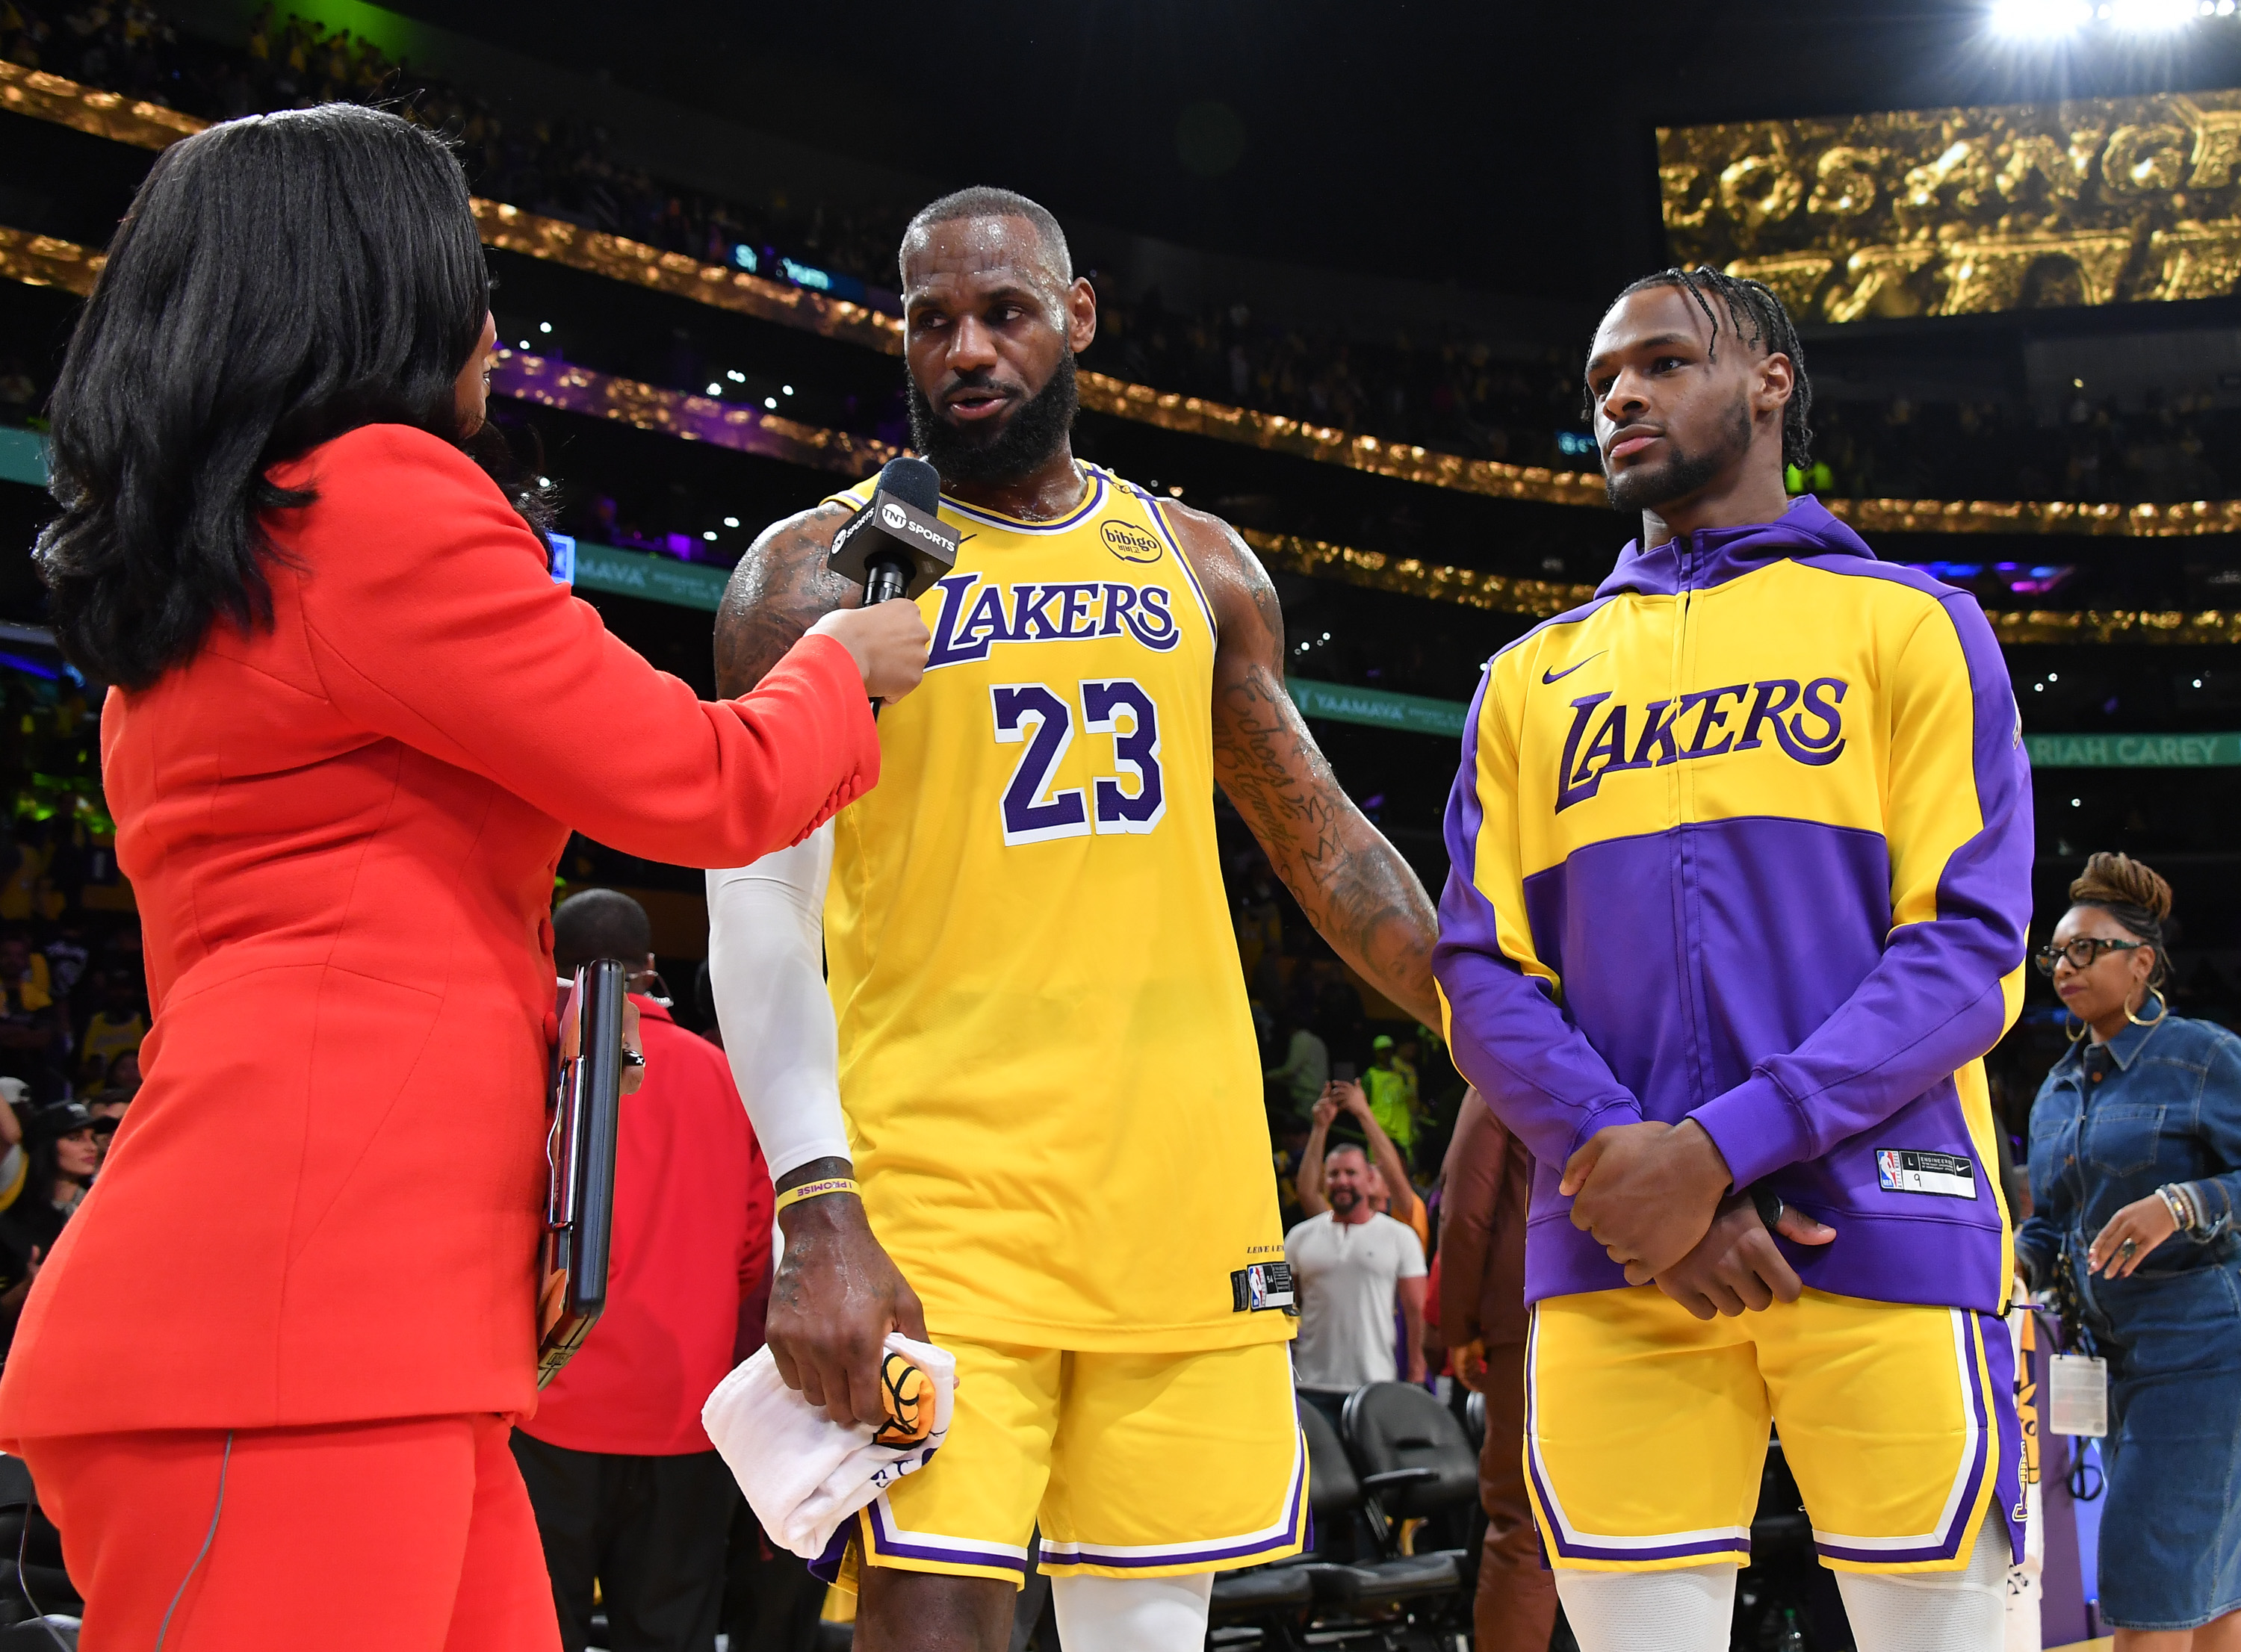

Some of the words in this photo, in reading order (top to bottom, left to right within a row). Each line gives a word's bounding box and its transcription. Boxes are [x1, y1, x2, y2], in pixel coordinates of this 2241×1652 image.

[846, 507, 875, 538] SPORTS
[882, 505, 907, 528] TNT
[908, 521, 955, 553] SPORTS
[1105, 528, 1157, 552] bibigo
[1118, 544, 1141, 554] 비비고
[923, 571, 1182, 672] LAKERS
[1555, 677, 1848, 816] LAKERS
[2031, 737, 2108, 765] RIAH
[2116, 736, 2219, 765] CAREY
[989, 677, 1167, 847] 23
[1908, 1157, 1914, 1166] L
[798, 1181, 847, 1196] PROMISE
